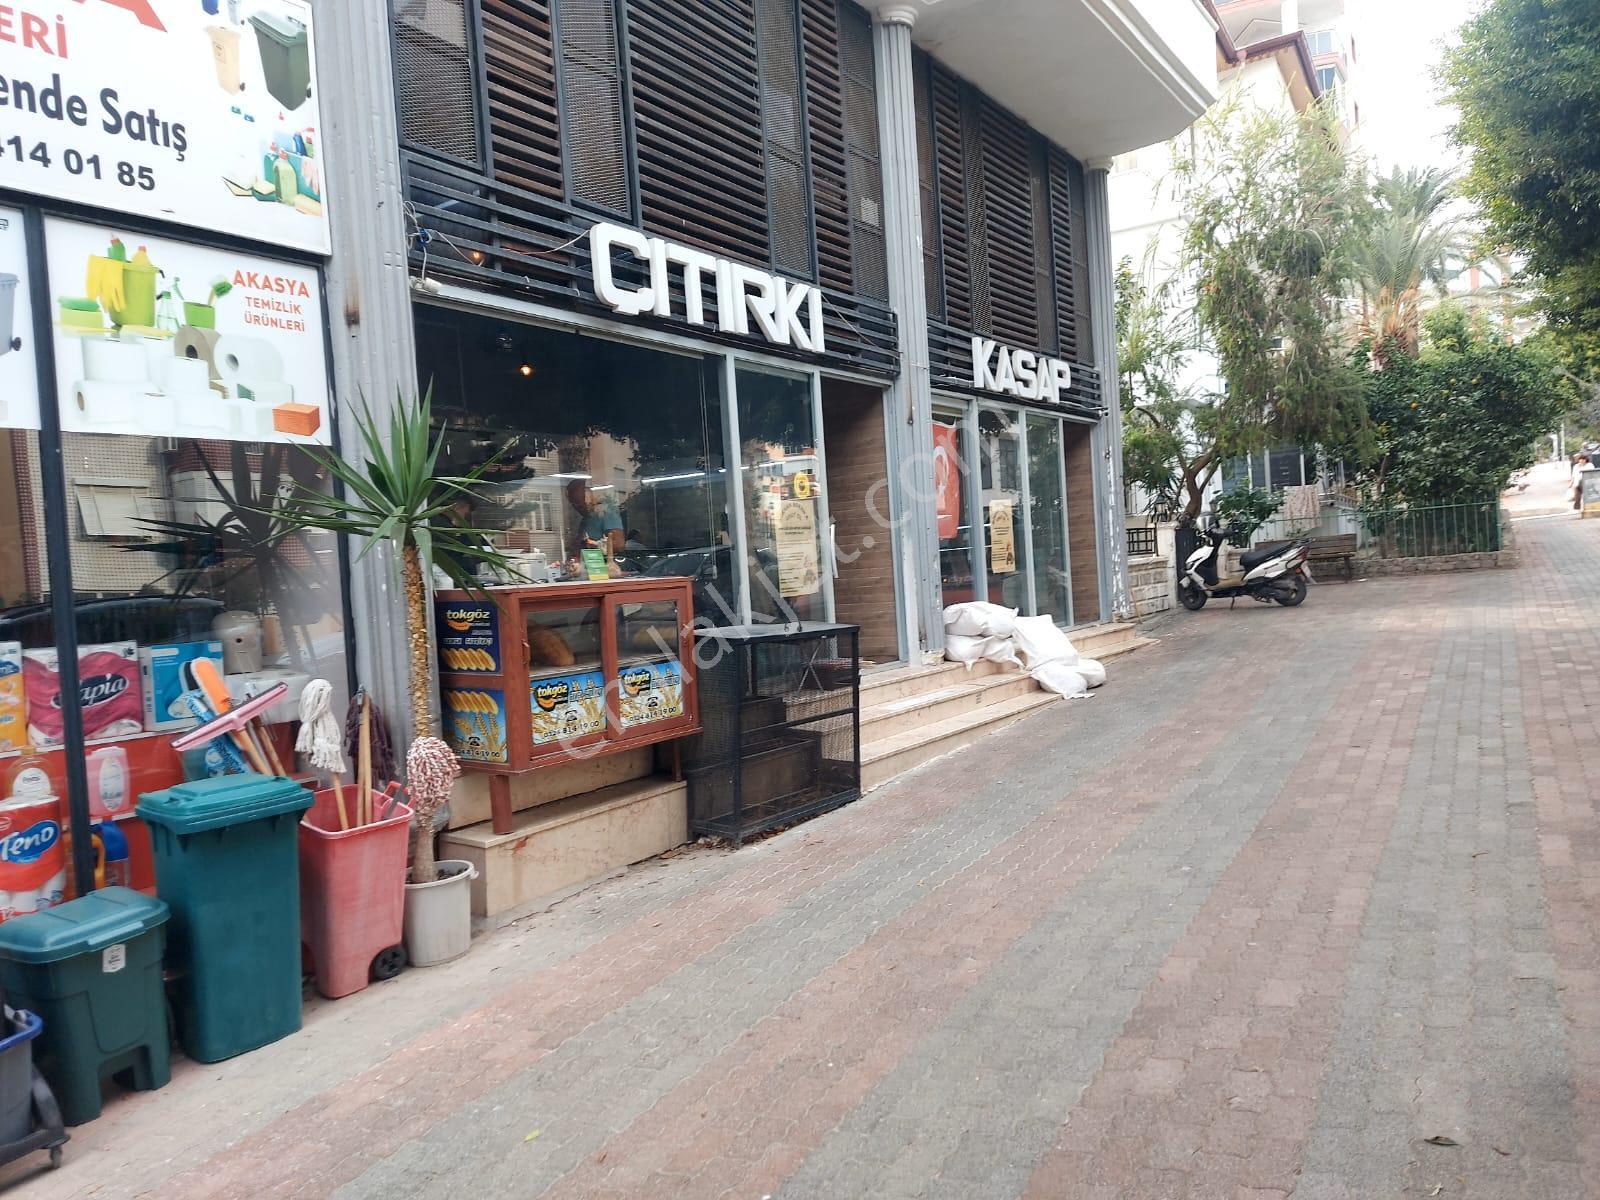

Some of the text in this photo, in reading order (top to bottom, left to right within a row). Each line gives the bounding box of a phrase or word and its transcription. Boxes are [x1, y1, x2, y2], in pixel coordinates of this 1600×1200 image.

[100, 88, 188, 162] Satış
[0, 135, 155, 191] 14 01 85
[233, 270, 310, 298] AKASYA
[245, 296, 302, 315] TEMİZLİK
[244, 311, 305, 332] ÜRÜNLERİ
[971, 336, 1072, 404] KASAP
[446, 608, 491, 622] tokgöz
[80, 673, 125, 706] apia
[536, 683, 568, 698] tokgöz
[622, 670, 650, 686] tokgöz
[0, 826, 55, 861] Teno
